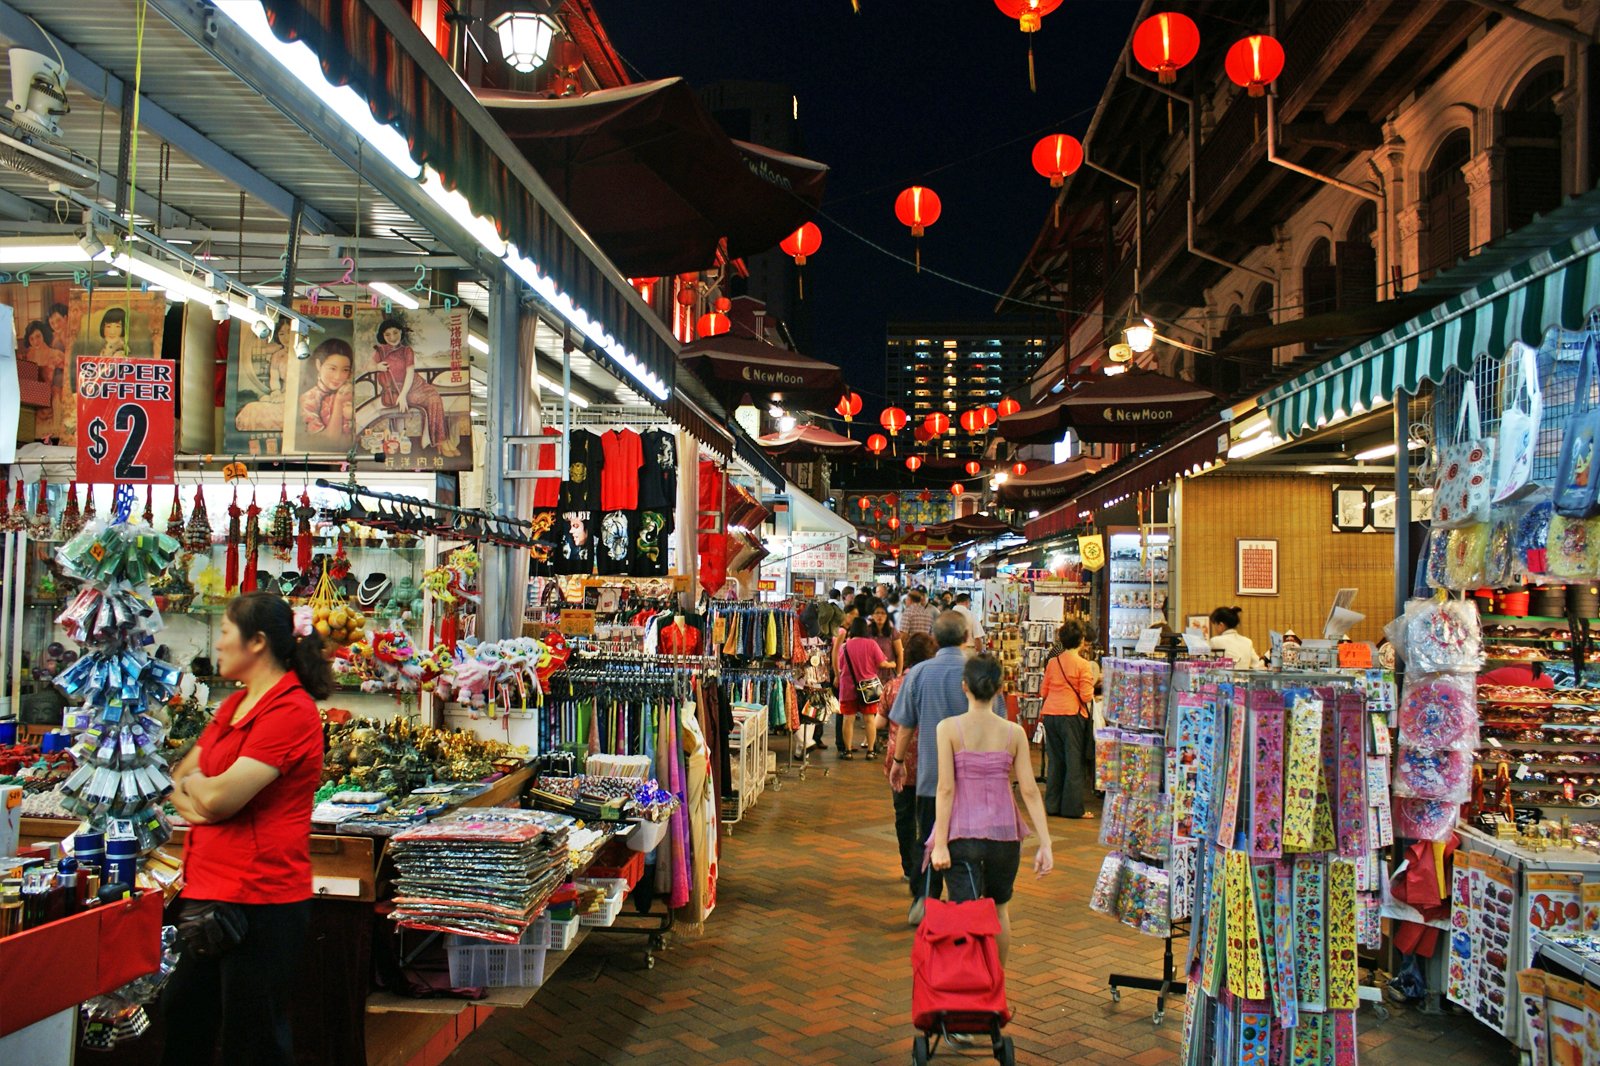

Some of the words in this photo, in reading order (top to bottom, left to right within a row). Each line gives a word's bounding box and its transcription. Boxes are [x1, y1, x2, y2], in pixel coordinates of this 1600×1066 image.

[80, 361, 173, 382] SUPER
[753, 368, 804, 384] NewMoon
[80, 381, 172, 401] OFFER
[1116, 408, 1173, 421] NewMoon
[87, 402, 149, 480] $2
